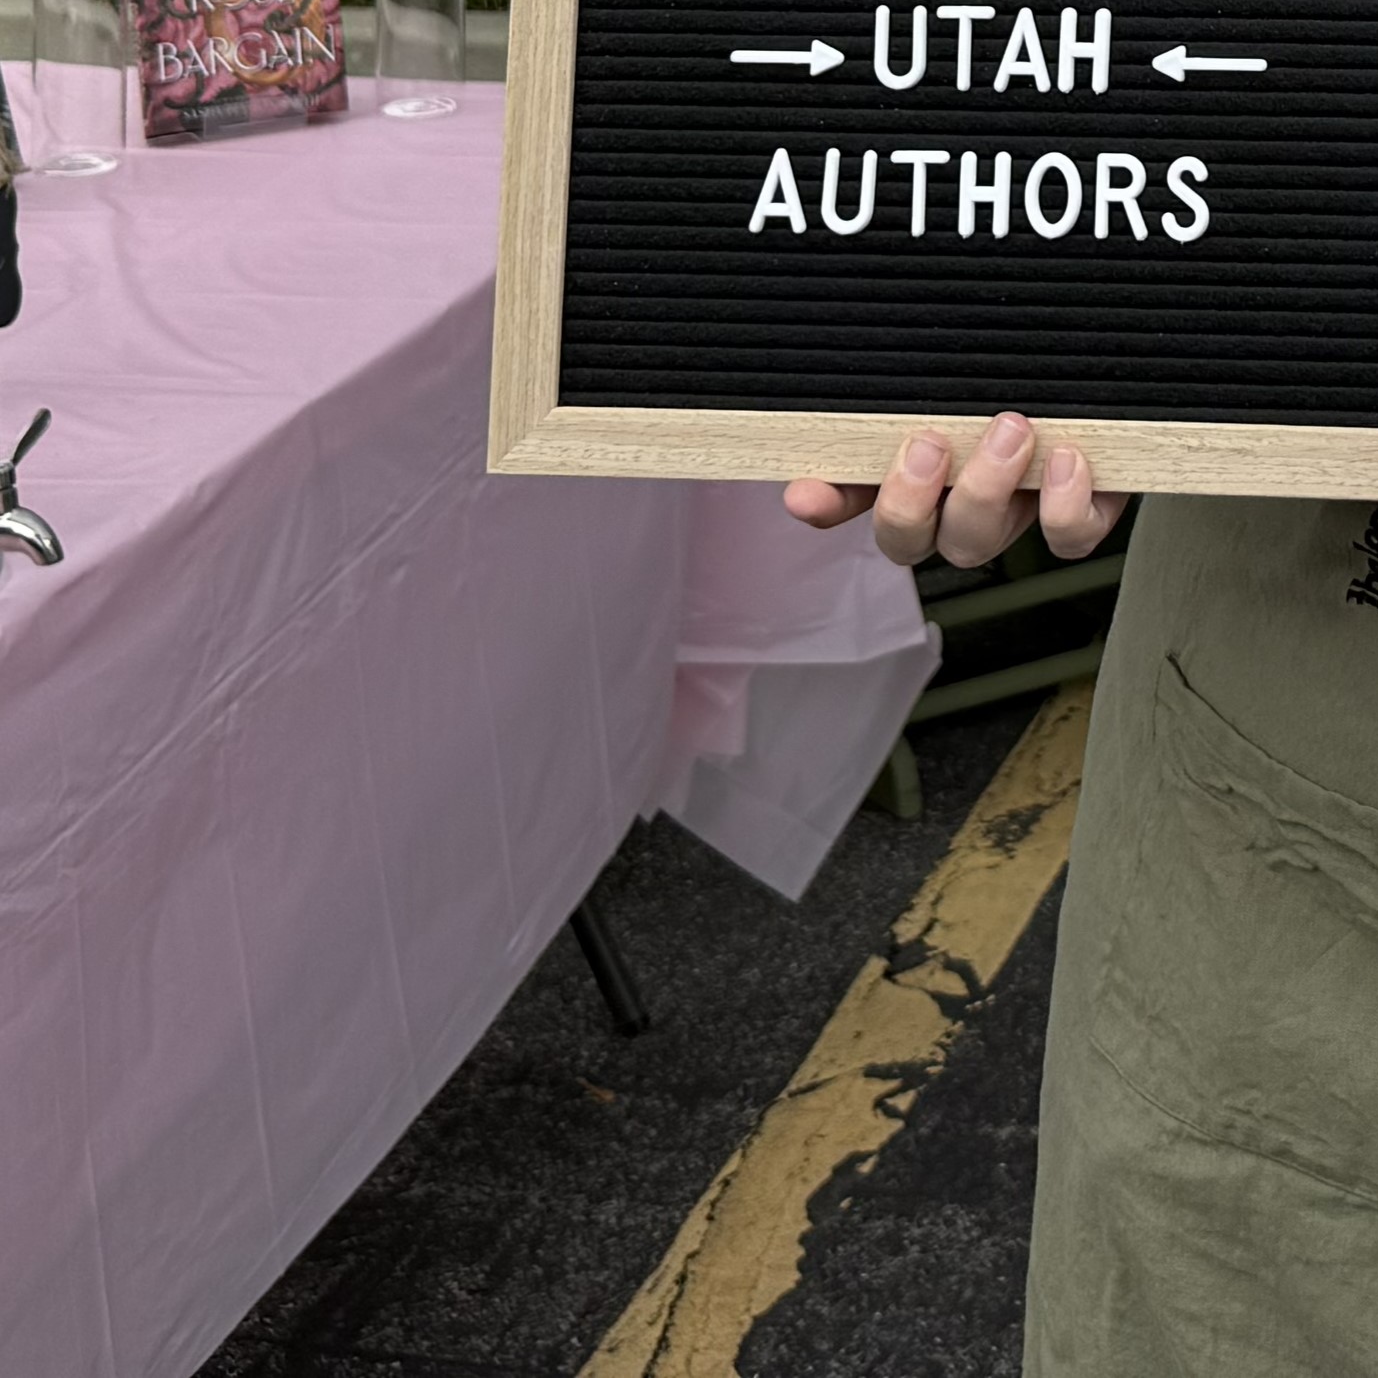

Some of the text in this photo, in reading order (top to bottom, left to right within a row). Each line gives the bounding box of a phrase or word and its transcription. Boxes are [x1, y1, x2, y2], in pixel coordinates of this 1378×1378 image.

[156, 23, 336, 84] BARGAIN
[873, 4, 1112, 95] UTAH
[748, 147, 1211, 244] AUTHORS
